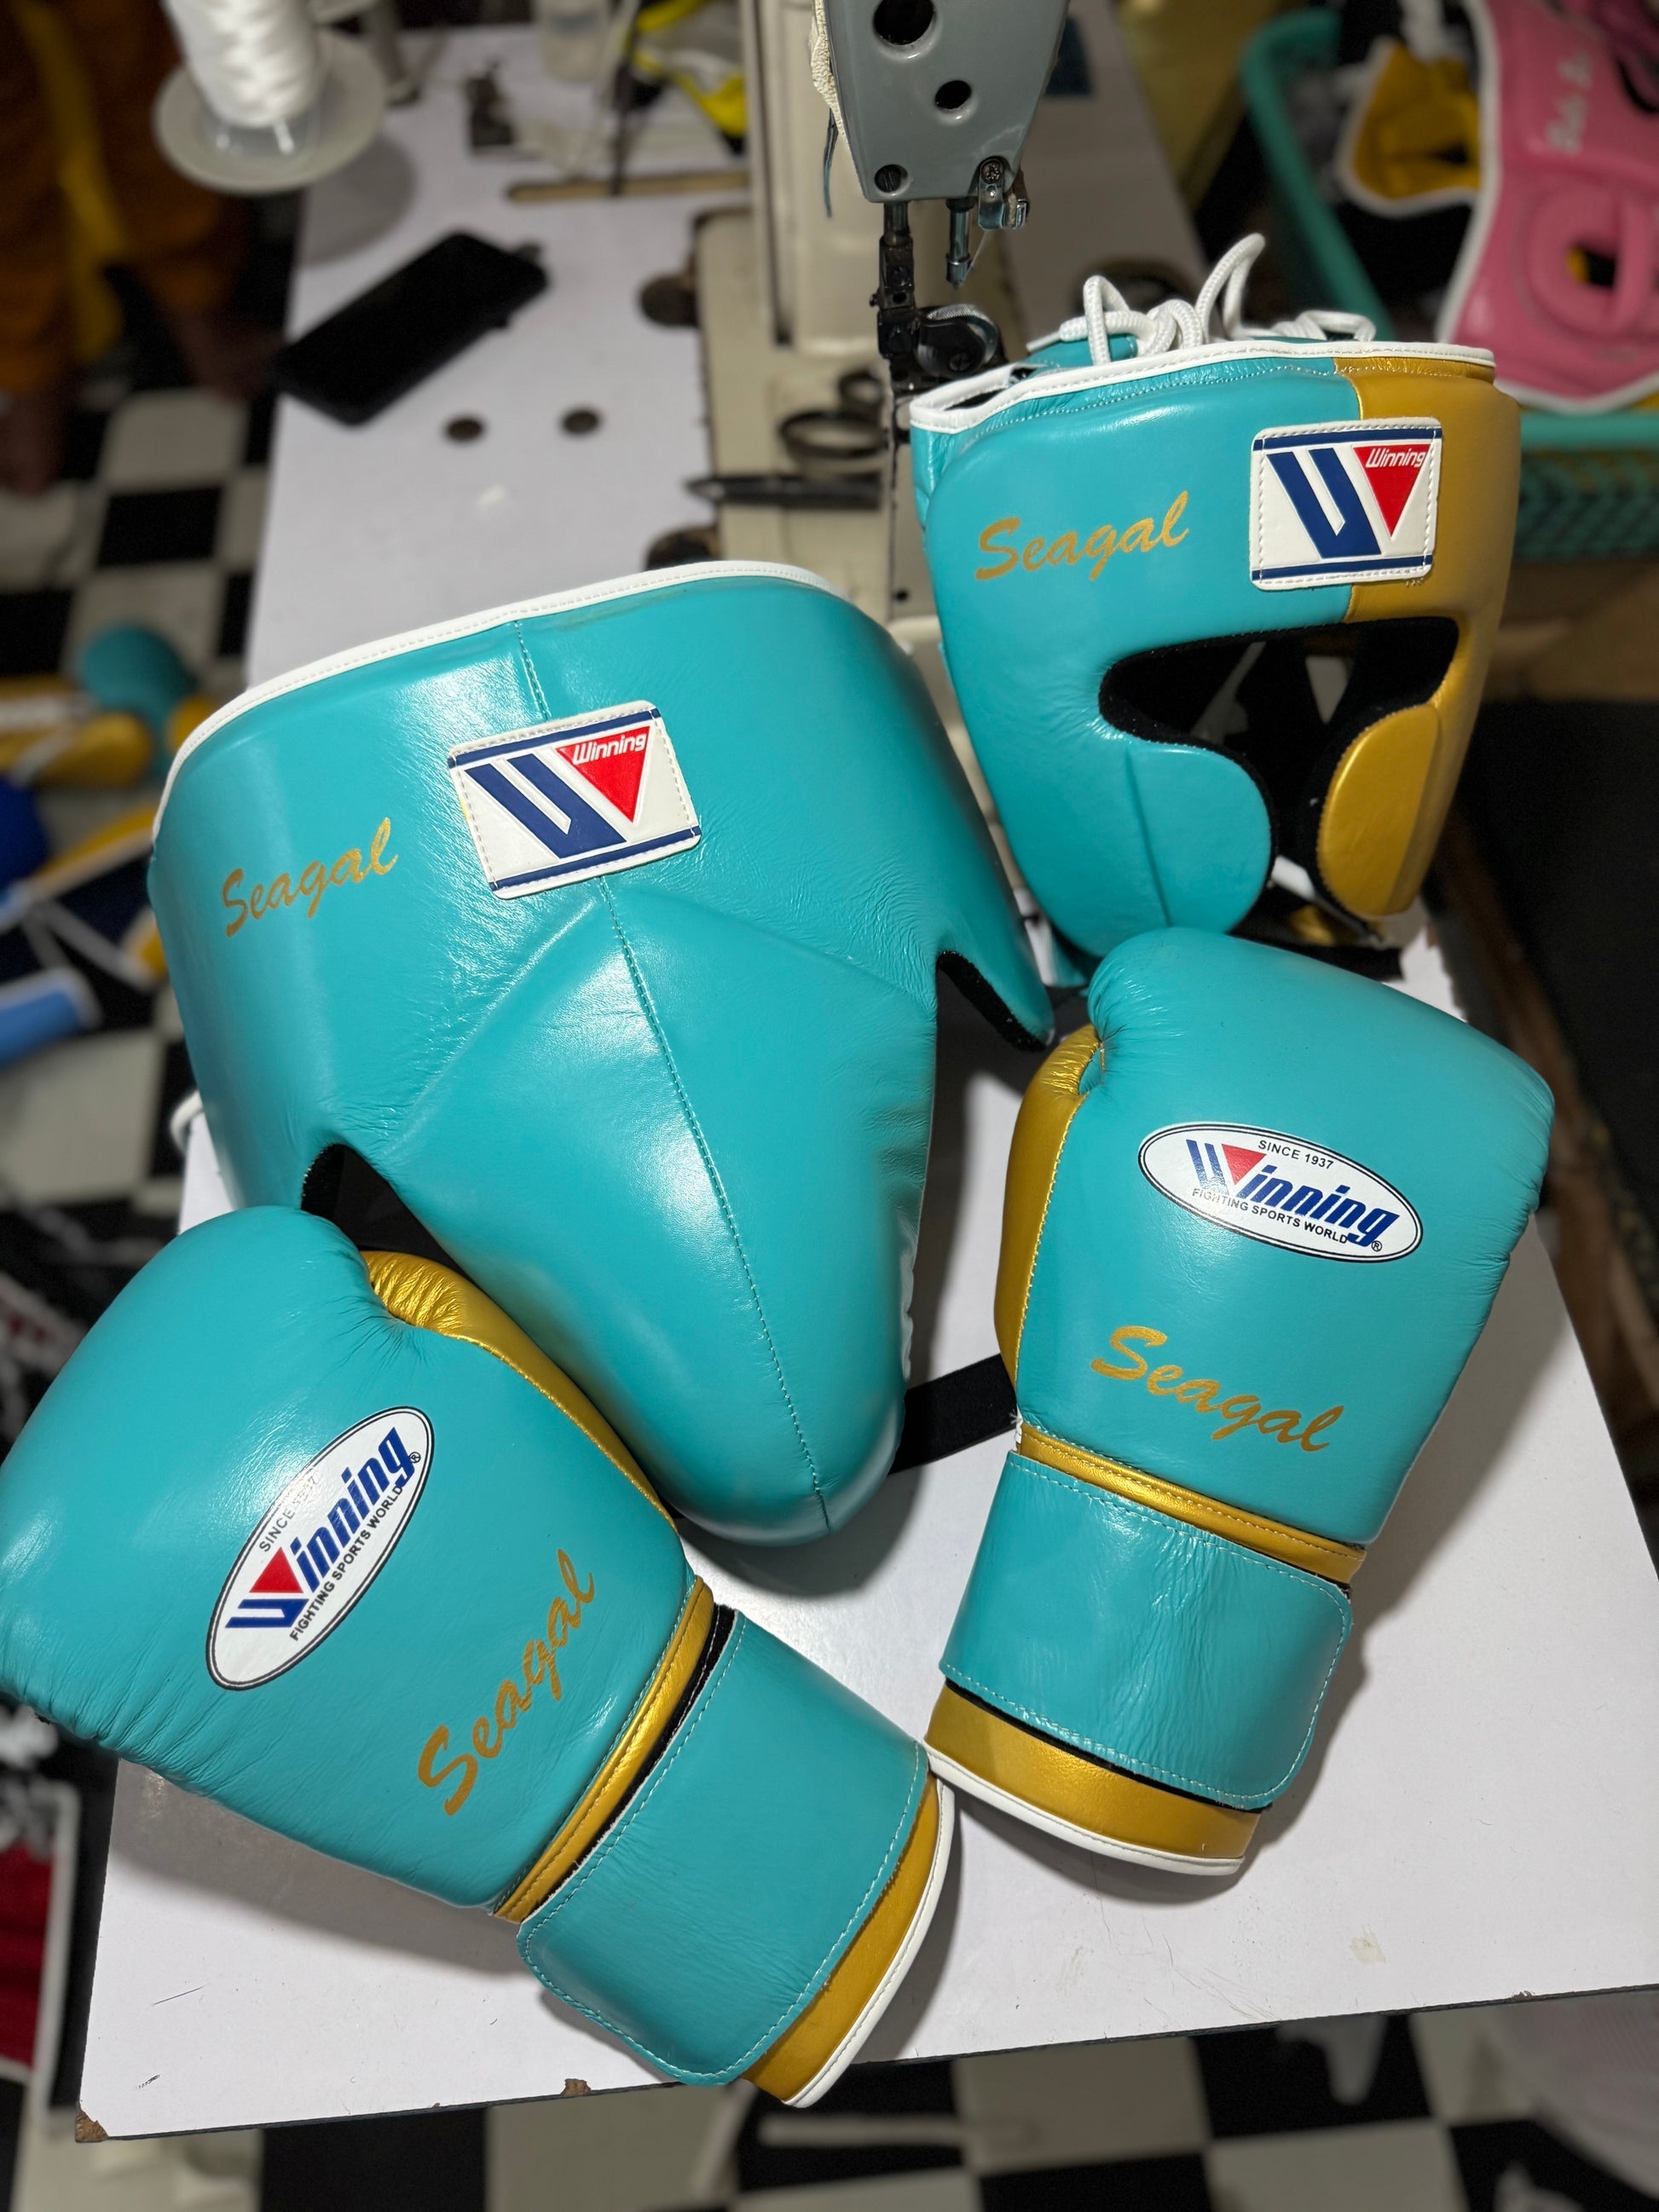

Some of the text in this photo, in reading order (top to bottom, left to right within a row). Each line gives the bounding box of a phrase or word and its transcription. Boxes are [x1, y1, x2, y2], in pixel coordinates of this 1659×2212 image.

[1365, 448, 1426, 468] Winning
[974, 491, 1189, 580] Seagal
[572, 733, 647, 765] Winning
[222, 817, 398, 937] Seagal
[1186, 1139, 1400, 1248] Winning
[1257, 1140, 1334, 1170] SINCE 1937
[1193, 1187, 1349, 1245] FIGHTING SPORTS WORLD
[1090, 1325, 1344, 1452] Seagal
[225, 1427, 415, 1629] Winning
[259, 1507, 296, 1553] SINCE
[289, 1486, 404, 1642] FIGHTING SPORTS WORLD
[418, 1548, 595, 1816] Seagal
